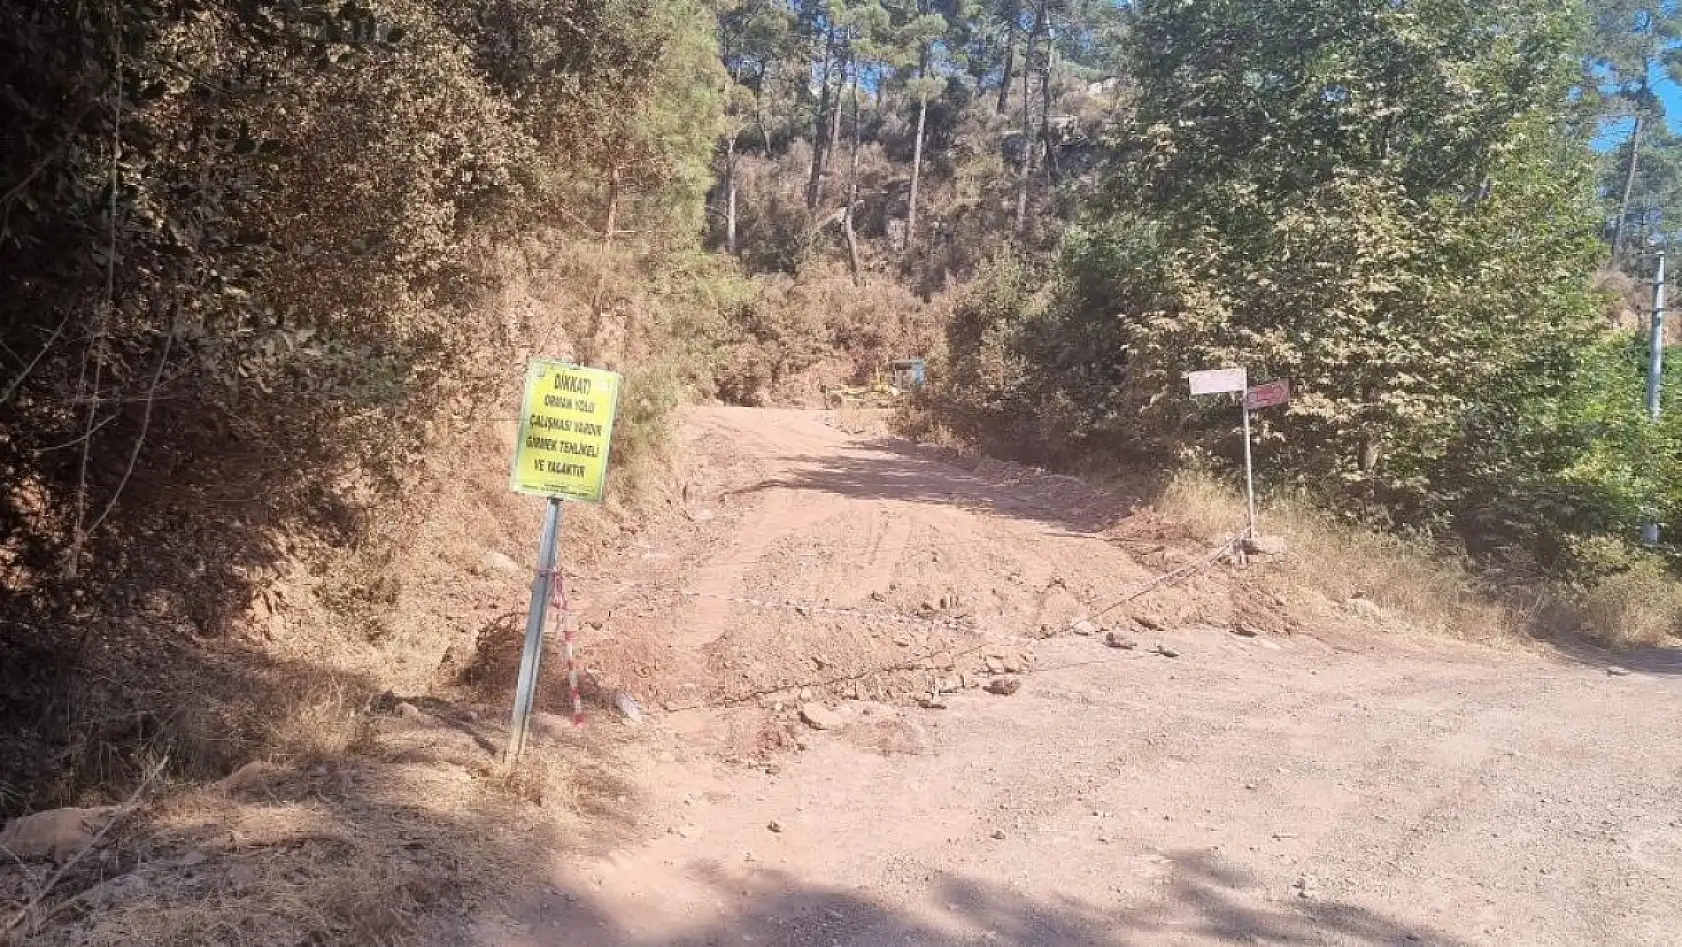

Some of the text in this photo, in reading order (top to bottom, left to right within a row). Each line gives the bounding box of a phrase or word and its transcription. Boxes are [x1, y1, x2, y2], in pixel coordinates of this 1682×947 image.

[544, 394, 573, 410] ORMAN
[529, 413, 573, 432] ÇALIŞMASI
[534, 458, 546, 472] VE
